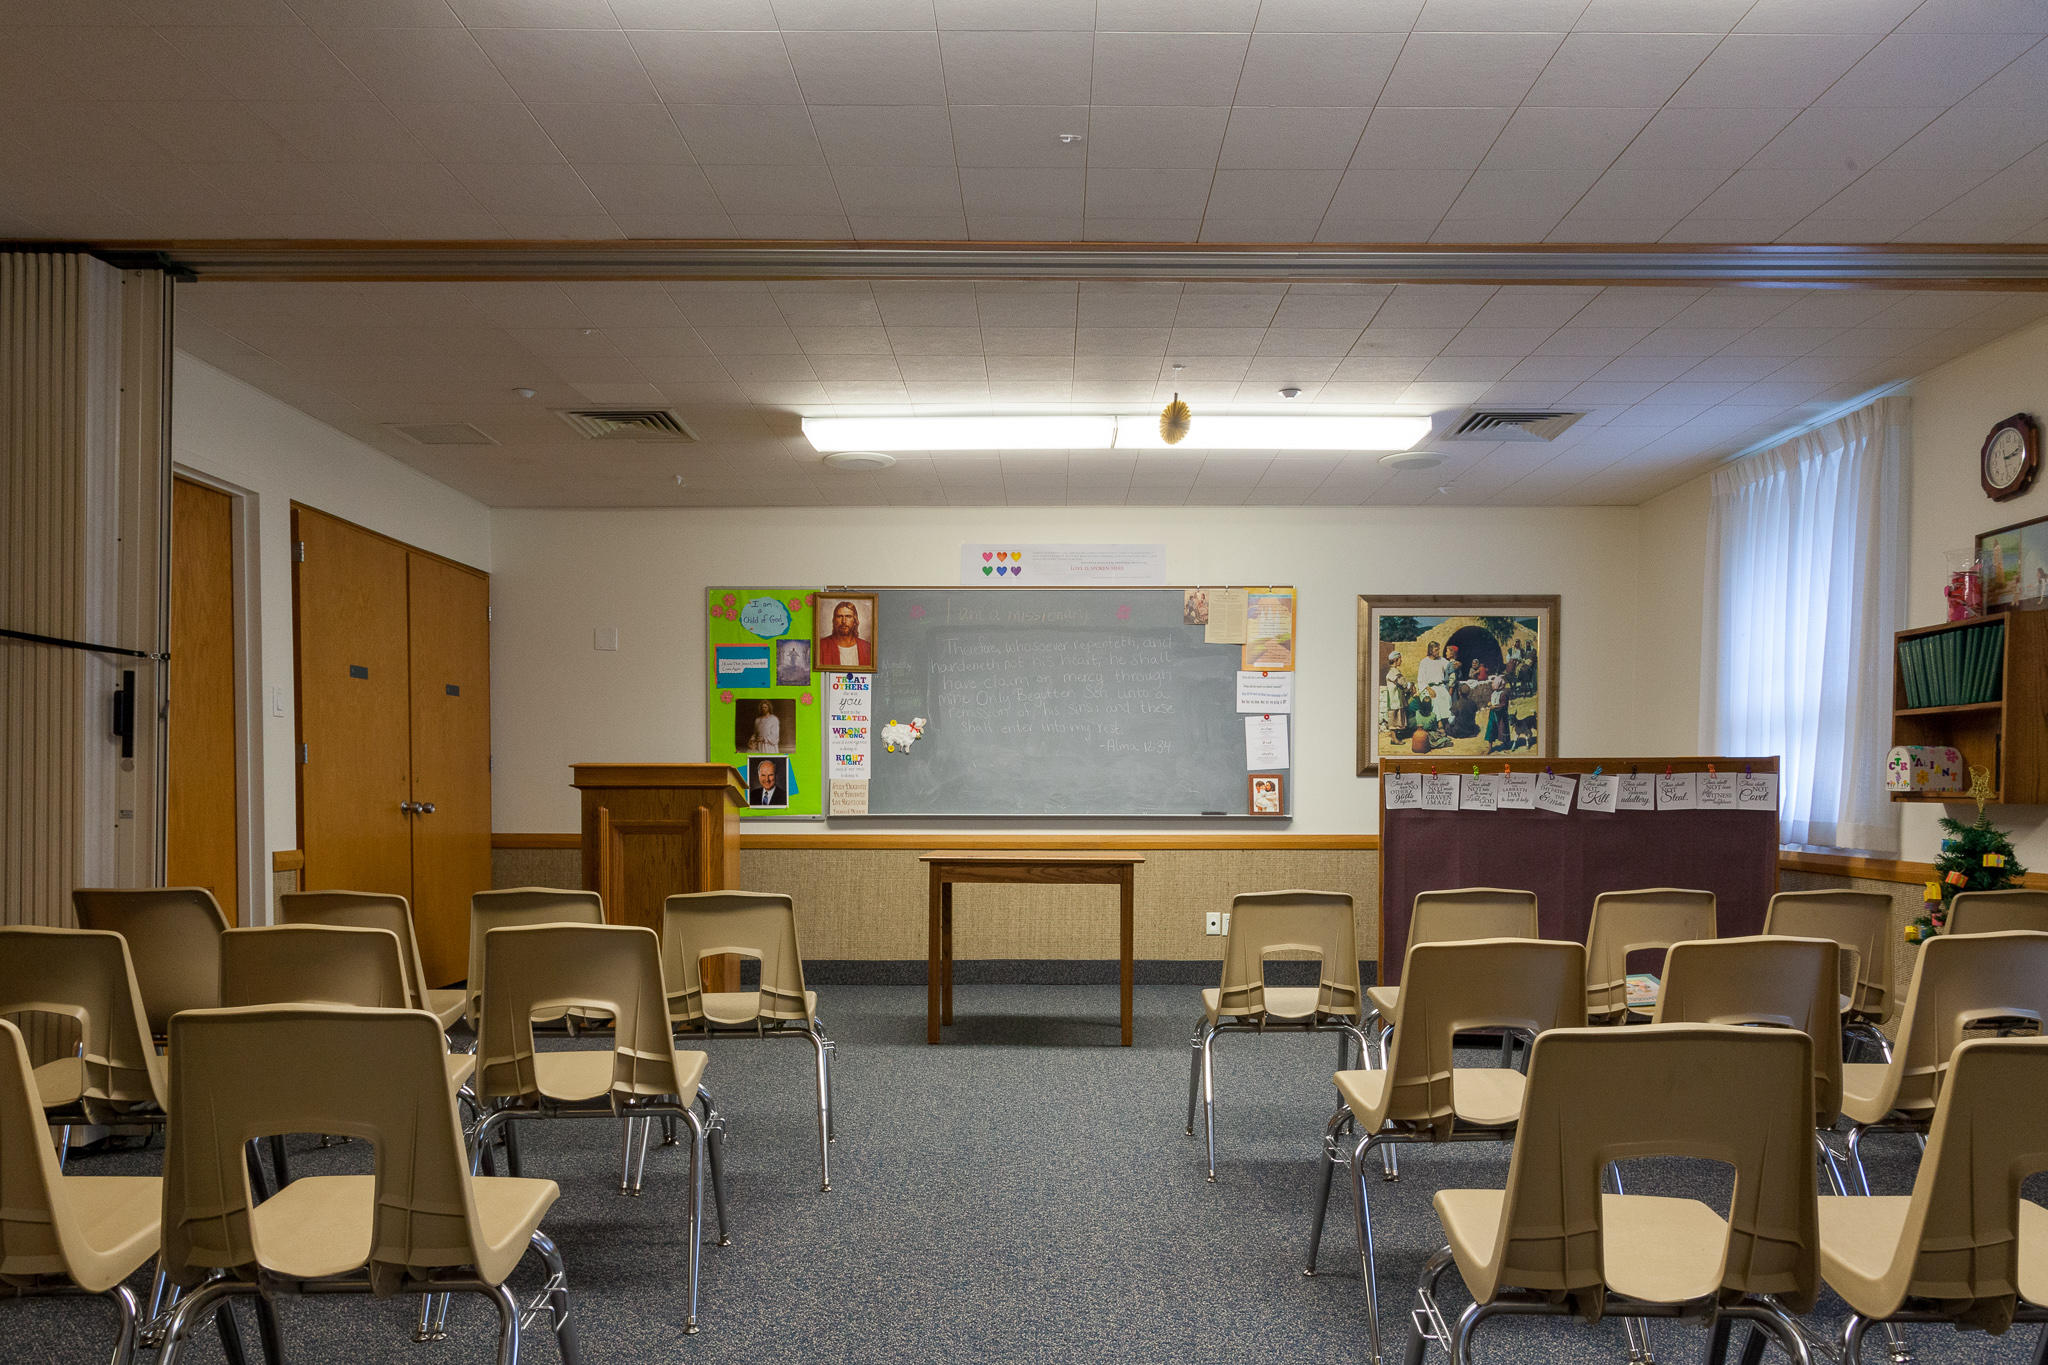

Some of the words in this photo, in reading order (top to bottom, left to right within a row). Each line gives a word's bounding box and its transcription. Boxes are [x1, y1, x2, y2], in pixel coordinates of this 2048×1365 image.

[752, 600, 760, 608] I
[743, 615, 759, 624] Child
[760, 613, 769, 624] of
[1142, 633, 1172, 649] and
[1109, 650, 1126, 665] he
[1131, 650, 1171, 665] shall
[942, 674, 977, 690] have
[839, 698, 863, 711] you
[1140, 700, 1177, 714] these
[961, 719, 994, 735] shall
[1000, 719, 1034, 734] enter
[1889, 757, 1908, 771] CTR
[1910, 754, 1958, 781] VALIANT
[1408, 783, 1419, 791] NO
[1428, 785, 1443, 793] NOT
[1394, 790, 1415, 805] gods
[1539, 791, 1551, 801] &
[1581, 790, 1610, 805] Kill
[1621, 794, 1650, 806] adultery
[1738, 788, 1769, 802] Covet
